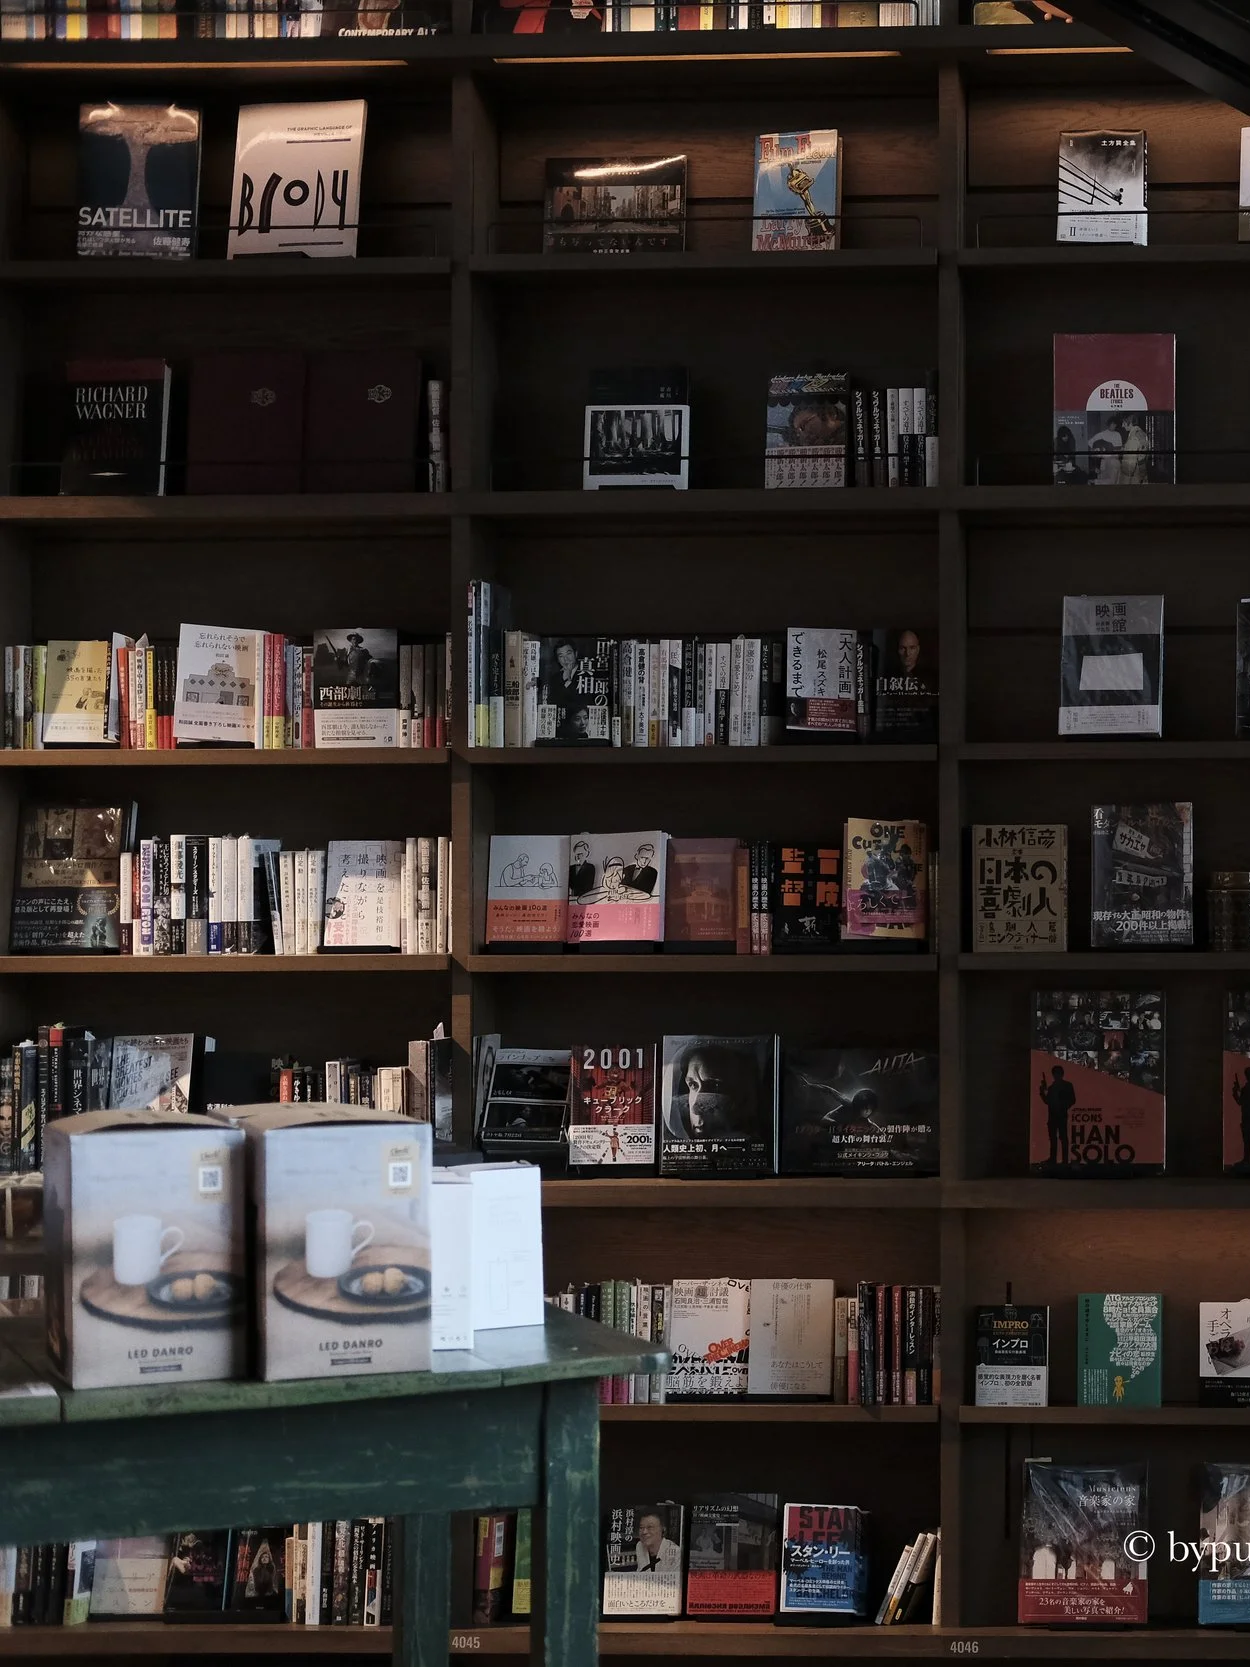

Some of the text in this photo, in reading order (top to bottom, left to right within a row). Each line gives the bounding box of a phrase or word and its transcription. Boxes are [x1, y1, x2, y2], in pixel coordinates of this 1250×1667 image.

[78, 206, 192, 228] SATELLITE
[75, 384, 149, 405] RICHARD
[1099, 388, 1134, 399] BEATLES
[75, 402, 147, 421] WAGNER
[199, 632, 246, 642] 忘れられそうで
[195, 641, 249, 652] 忘れられない映画
[791, 631, 805, 698] できるまで
[838, 632, 853, 700] 「大人計画」
[576, 656, 596, 695] 真相
[816, 648, 827, 697] 松尾スズキ
[870, 822, 906, 839] ONE
[978, 827, 1056, 848] 小林信彦
[851, 834, 883, 850] CUT
[1119, 831, 1147, 852] サカエヤ
[376, 853, 387, 893] 映画を
[979, 856, 1058, 885] 日本の
[358, 853, 369, 921] 撮りながら
[15, 898, 73, 906] ファンの声にこたえ、
[978, 885, 1058, 919] 喜劇人
[571, 912, 600, 920] みんなの
[571, 921, 600, 929] 恋愛映画
[1115, 920, 1192, 932] 200件以上掲載!
[570, 929, 592, 938] 100選
[115, 1054, 130, 1067] THE
[583, 1048, 645, 1070] 2001
[860, 1051, 925, 1076] ALITA
[115, 1055, 153, 1079] GREATEST
[114, 1072, 143, 1088] MOVIES
[165, 1066, 179, 1084] SEE
[583, 1096, 642, 1106] キューブリック
[595, 1106, 631, 1114] クラーク
[1071, 1113, 1103, 1123] ICONS
[626, 1135, 652, 1144] 2001:
[1070, 1125, 1120, 1145] HAN
[1070, 1144, 1135, 1164] SOLO
[772, 1281, 813, 1291] 俳優の仕事
[992, 1319, 1030, 1330] IMPRO
[1219, 1307, 1232, 1339] オペラ
[319, 1338, 383, 1352] LED DANRO
[708, 1338, 734, 1354] OVER
[992, 1338, 1029, 1349] インプロ
[128, 1345, 194, 1360] LED DANRO
[770, 1361, 824, 1370] あなたはこうして
[769, 1381, 807, 1391] 俳優になる
[1077, 1493, 1137, 1508] 音楽家の家
[625, 1508, 635, 1542] 浜村淳の
[799, 1506, 857, 1530] STAN
[610, 1508, 623, 1567] 浜村映画史
[790, 1545, 851, 1559] スタン・リー
[607, 1599, 666, 1608] 面白いところだけを
[1038, 1597, 1106, 1607] 23名の音楽家の家を
[1063, 1605, 1126, 1616] 美しい写真で紹介!
[452, 1636, 481, 1649] 4045
[950, 1641, 979, 1654] 4046
